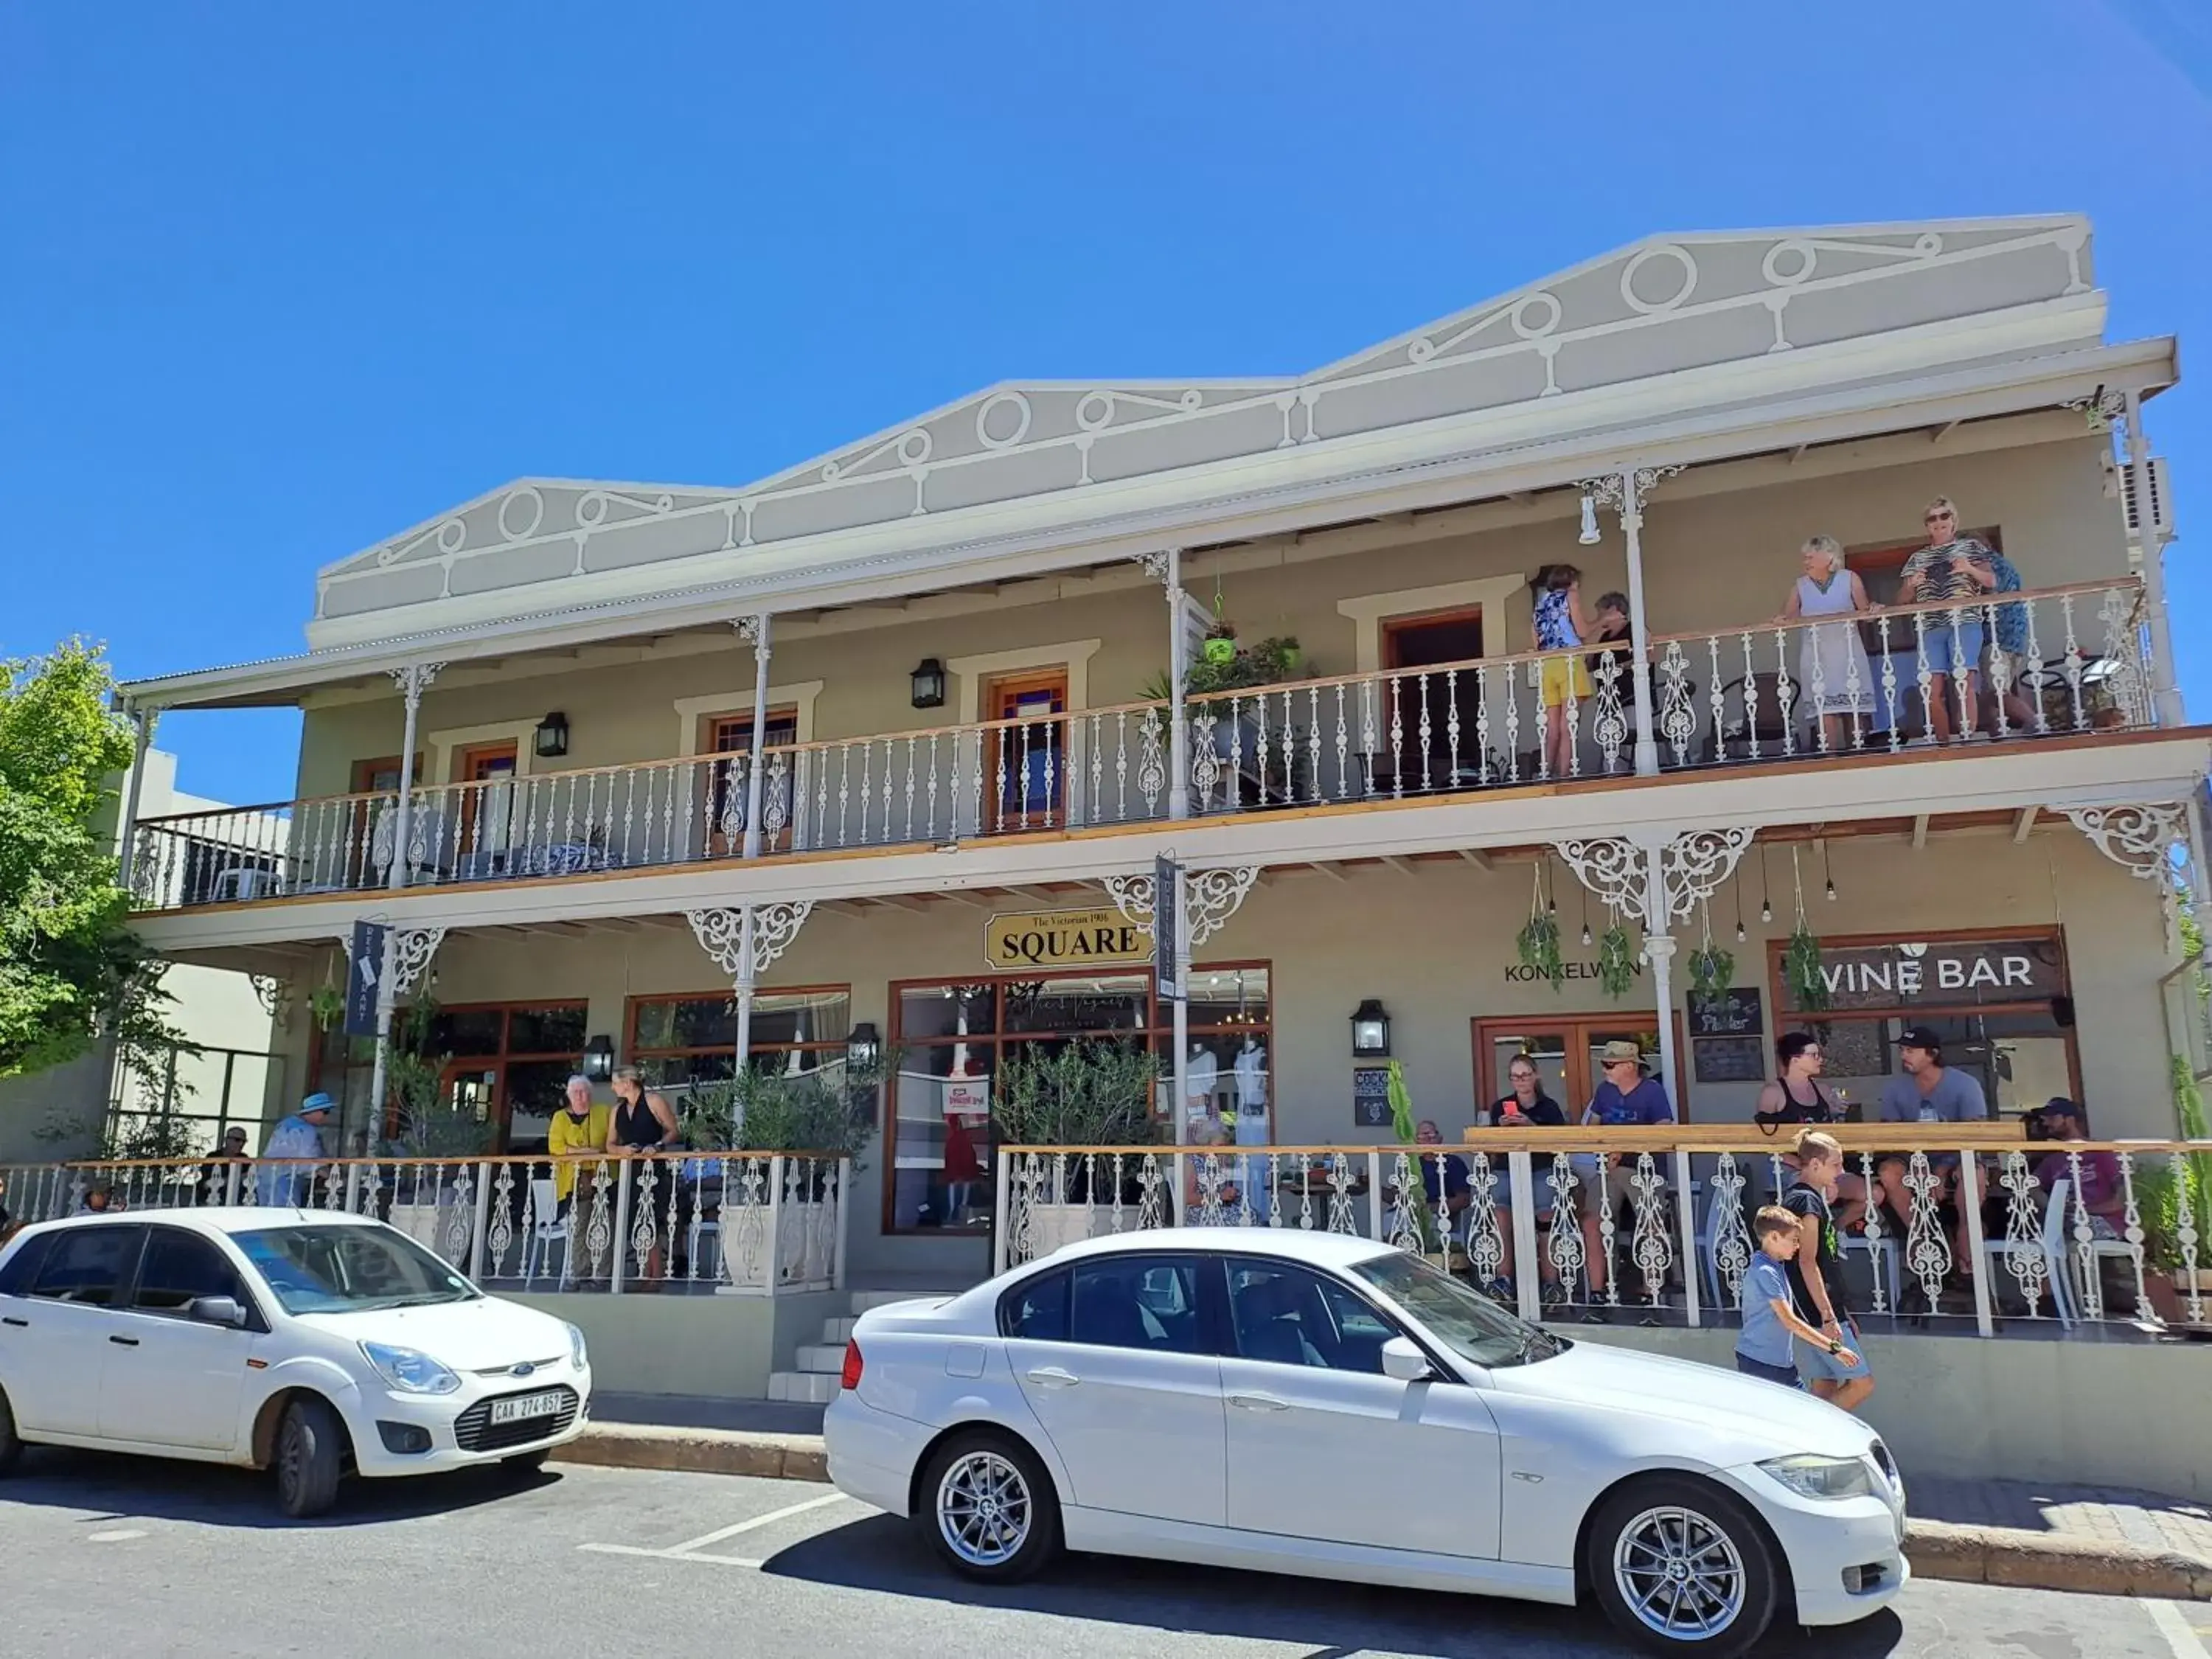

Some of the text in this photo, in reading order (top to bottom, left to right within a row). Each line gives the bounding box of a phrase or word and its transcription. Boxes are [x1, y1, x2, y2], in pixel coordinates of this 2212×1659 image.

[1033, 917, 1048, 927] The
[1002, 926, 1139, 964] SQUARE
[1936, 956, 2034, 988] BAR
[495, 1403, 515, 1420] CAA
